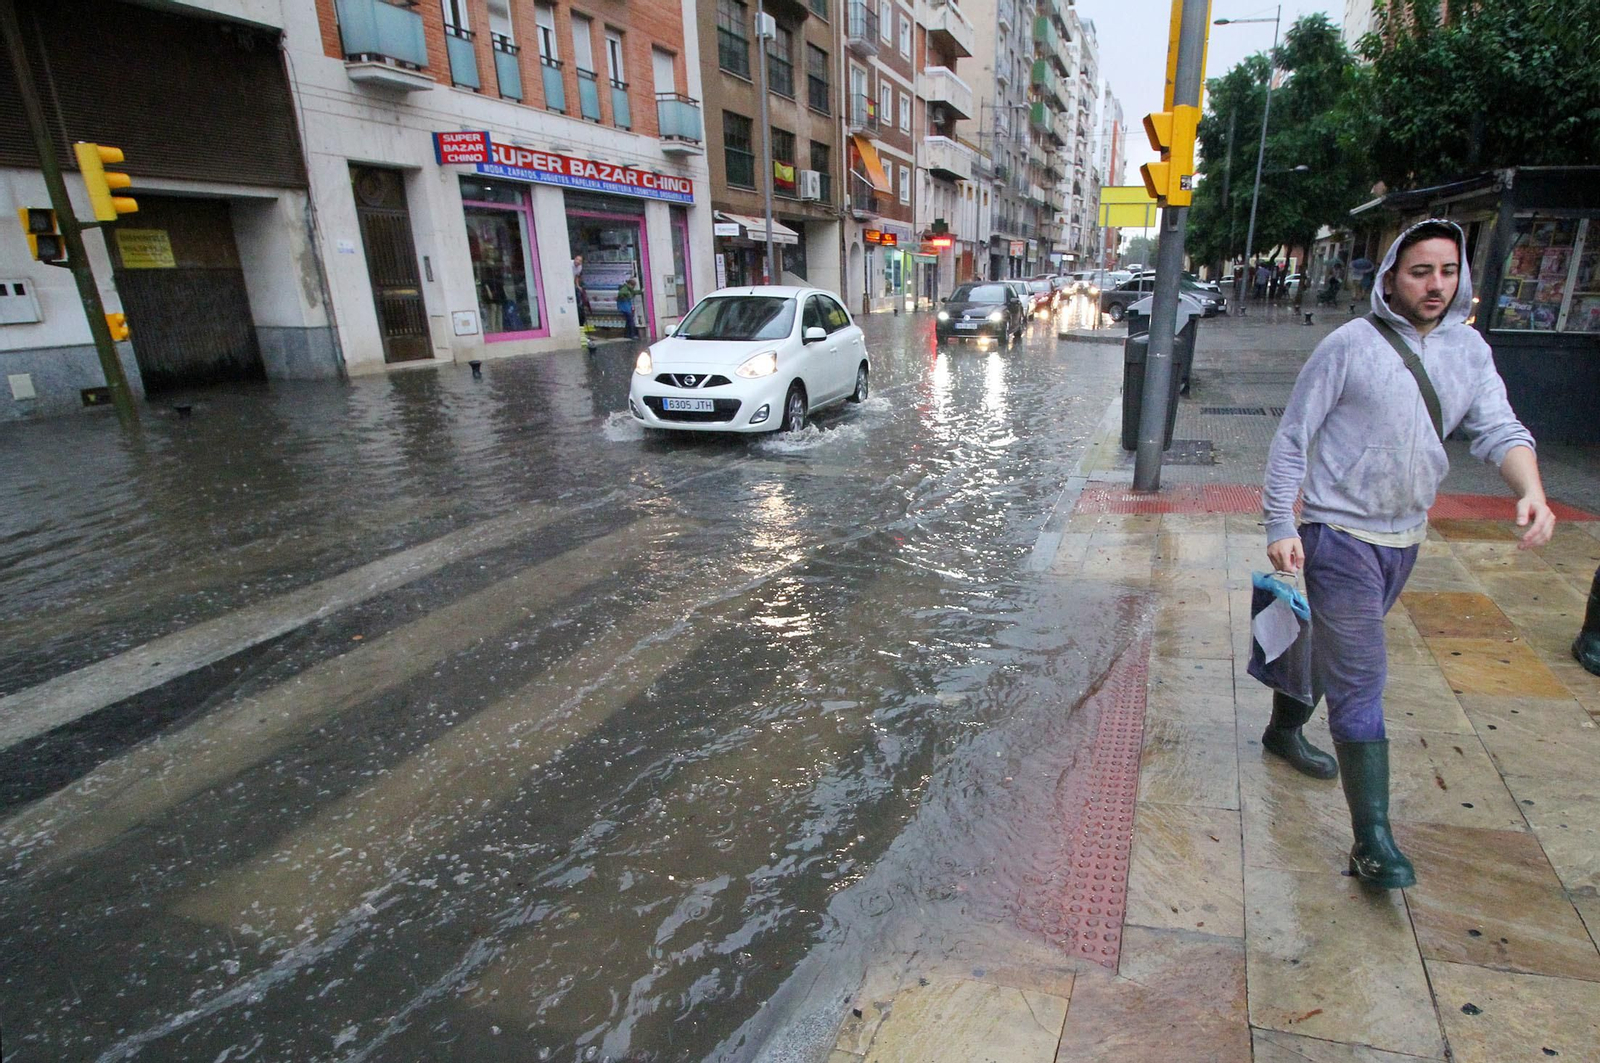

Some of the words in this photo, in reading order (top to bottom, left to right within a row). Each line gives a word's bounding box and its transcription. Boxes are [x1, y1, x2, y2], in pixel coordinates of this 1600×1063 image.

[443, 133, 481, 142] SUPER
[443, 143, 484, 152] BAZAR
[447, 154, 482, 162] CHINO
[491, 145, 564, 173] SUPER
[570, 160, 638, 186] BAZAR
[643, 173, 690, 193] CHINO
[669, 400, 691, 409] 6305
[695, 401, 712, 410] JTH
